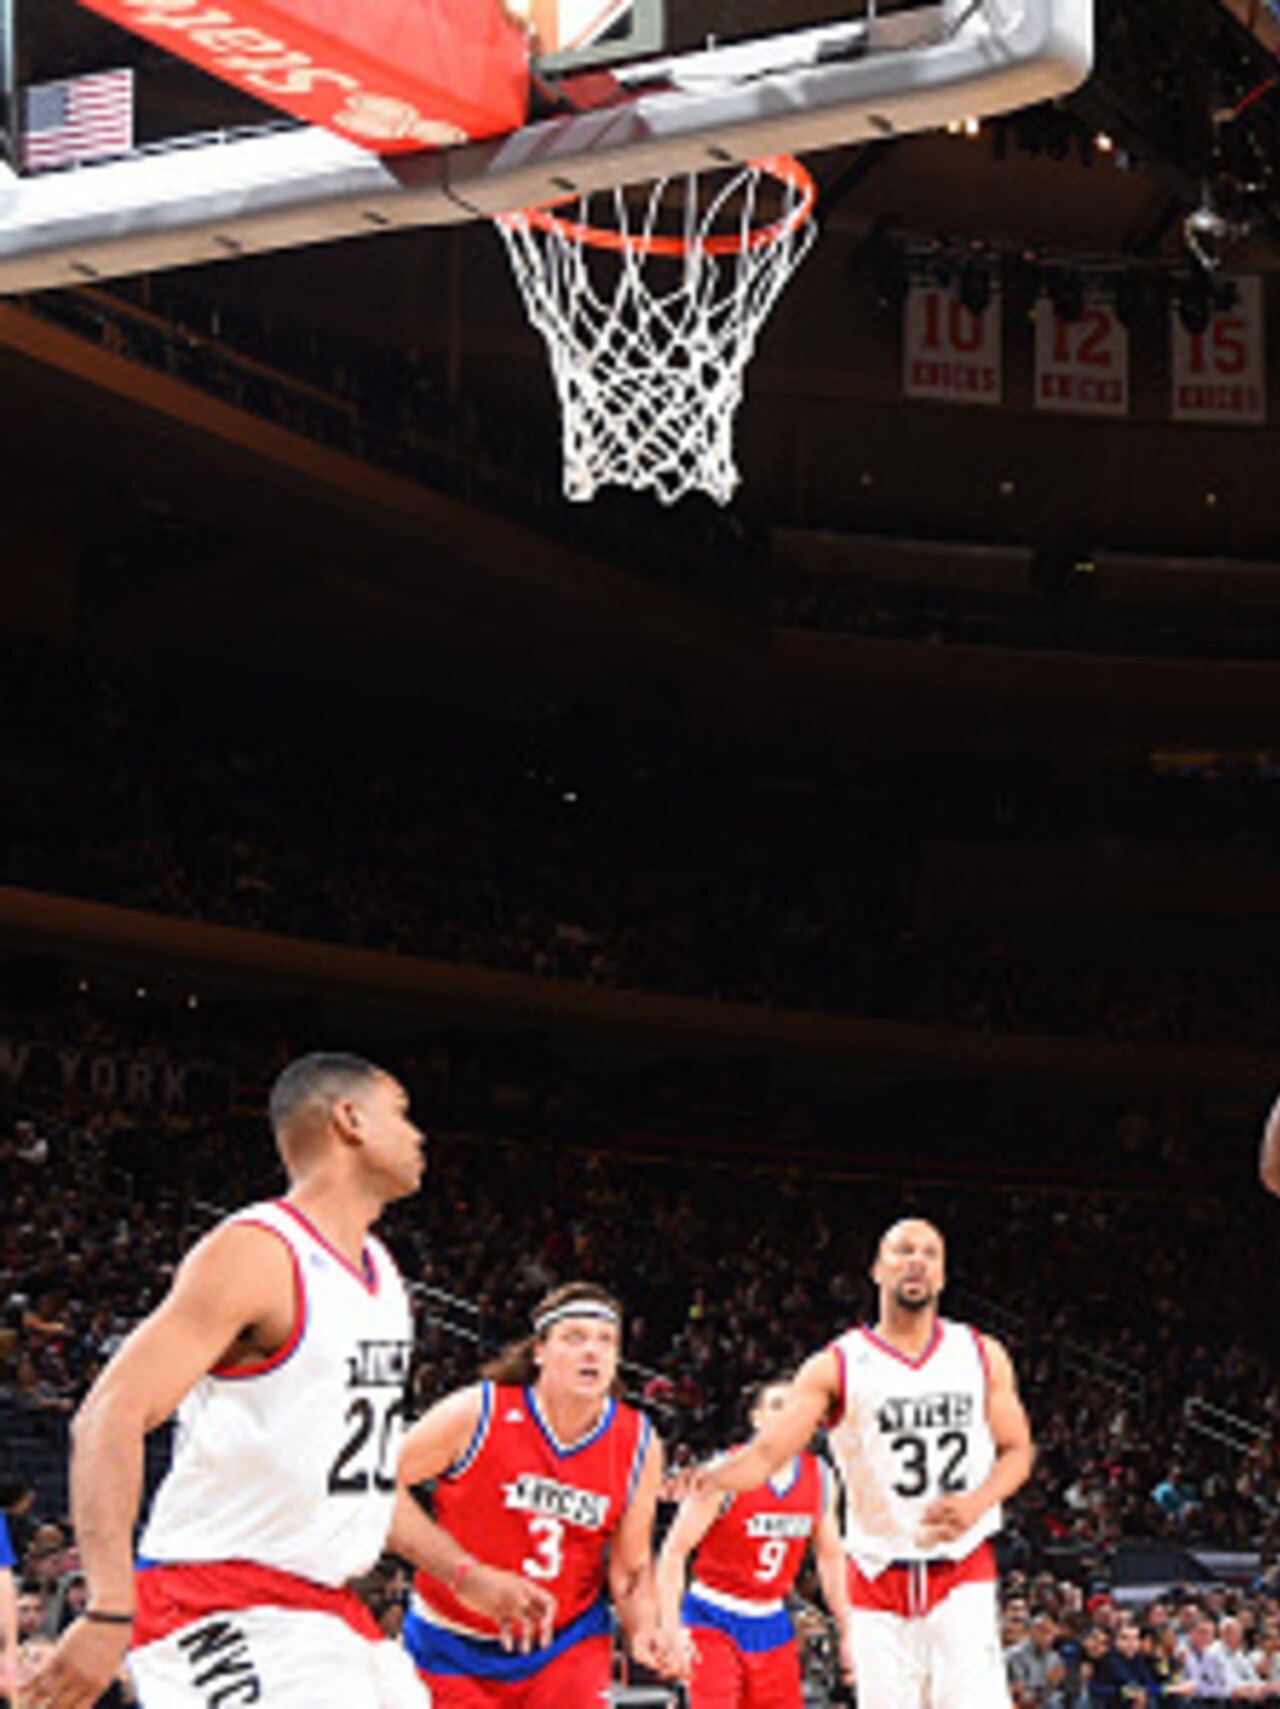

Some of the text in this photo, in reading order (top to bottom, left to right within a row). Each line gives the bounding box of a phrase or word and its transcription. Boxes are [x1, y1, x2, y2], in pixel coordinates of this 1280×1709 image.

[890, 1431, 969, 1498] 32
[522, 1518, 565, 1579] 3
[753, 1538, 791, 1583] 9
